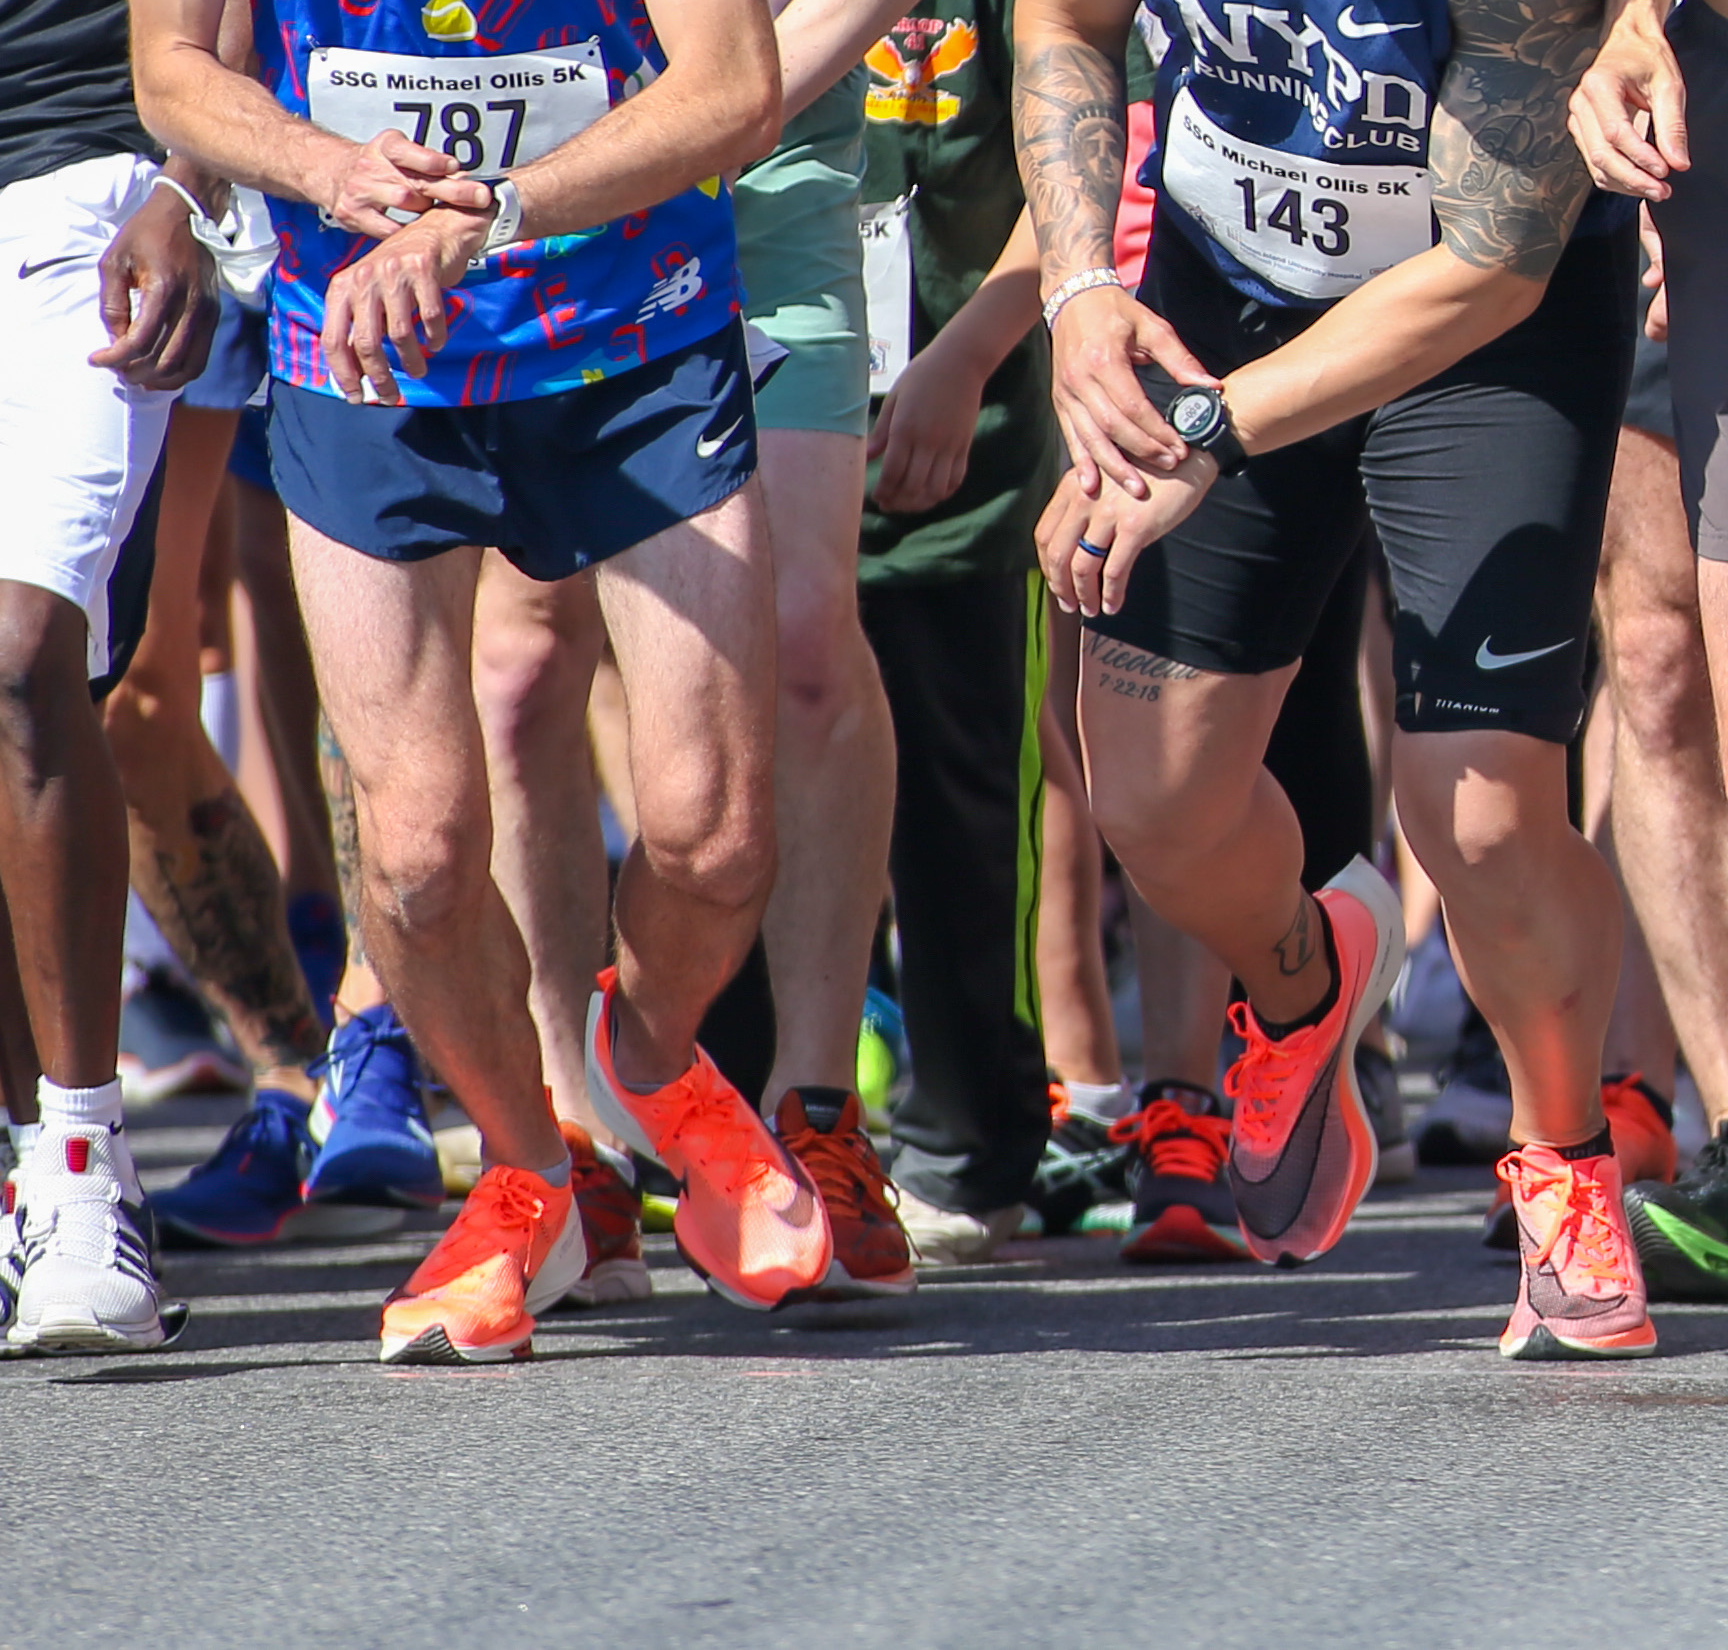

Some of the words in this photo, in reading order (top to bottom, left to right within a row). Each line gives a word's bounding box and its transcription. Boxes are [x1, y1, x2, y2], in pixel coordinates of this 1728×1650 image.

[329, 69, 378, 89] SSG
[386, 73, 482, 91] Michael
[489, 71, 545, 90] Ollis
[552, 63, 588, 83] 5K
[1194, 54, 1330, 134] RUNNING
[1322, 127, 1422, 153] CLUB
[392, 98, 527, 171] 787
[1181, 113, 1217, 151] SSG
[1221, 144, 1308, 185] Michael
[1315, 174, 1370, 195] Ollis
[1376, 181, 1413, 197] 5K
[858, 221, 890, 240] 5K
[1233, 175, 1351, 258] 143
